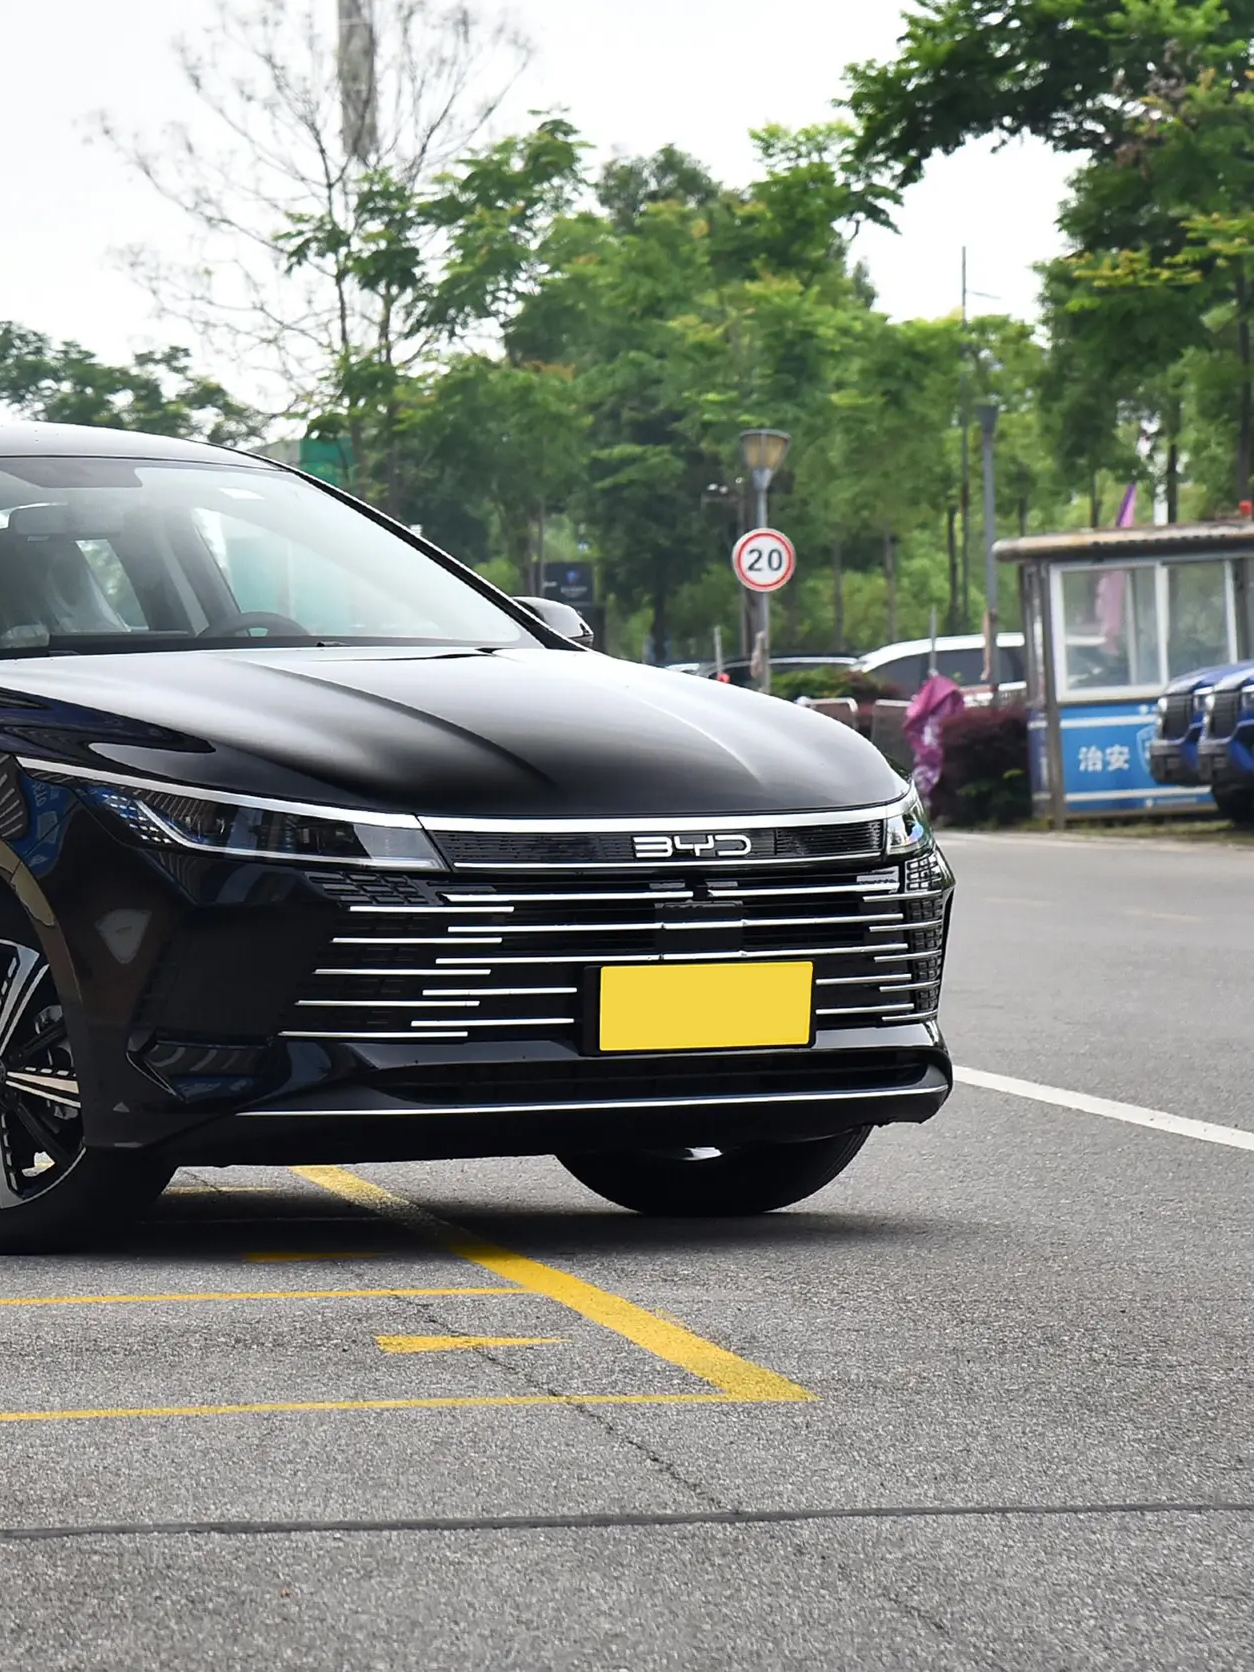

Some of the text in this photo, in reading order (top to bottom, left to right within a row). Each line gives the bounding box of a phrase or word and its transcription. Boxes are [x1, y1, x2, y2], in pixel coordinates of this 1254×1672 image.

[747, 548, 782, 571] 20
[1078, 744, 1130, 772] 治安
[632, 833, 752, 858] BYD
